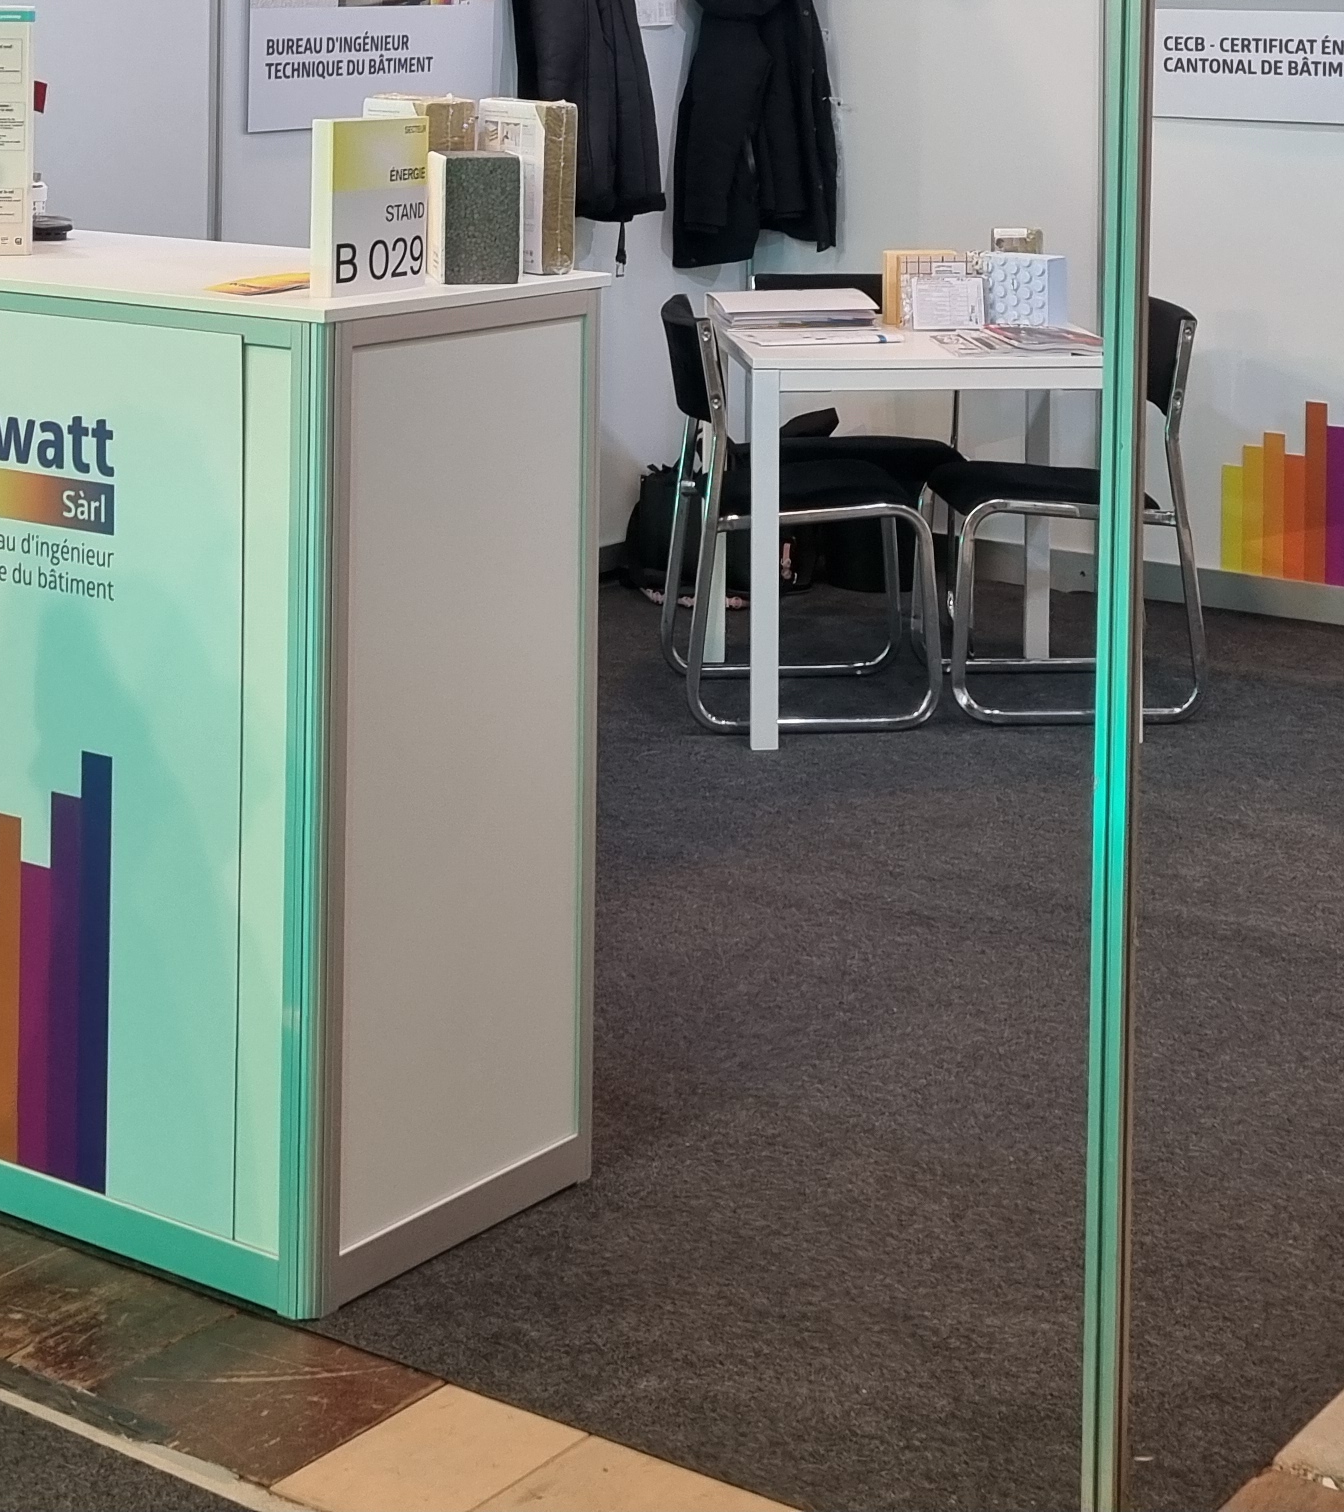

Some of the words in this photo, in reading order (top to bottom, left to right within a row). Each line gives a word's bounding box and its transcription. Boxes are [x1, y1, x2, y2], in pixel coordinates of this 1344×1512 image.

[265, 35, 322, 57] BUREAU
[325, 30, 410, 55] D'INGÉNIEUR
[1162, 35, 1206, 53] CECB
[1219, 37, 1317, 56] CERTIFICAT
[265, 58, 343, 80] TECHNIQUE
[346, 57, 365, 77] DU
[368, 51, 433, 76] BÂTIMENT
[1162, 56, 1257, 76] CANTONAL
[1260, 58, 1284, 77] DE
[389, 166, 426, 182] ÉNERGIE
[385, 201, 425, 223] STAND
[335, 242, 357, 284] B
[368, 235, 424, 281] 029
[62, 490, 106, 523] Sàrl
[20, 533, 115, 569] d'ingénieur
[12, 566, 32, 586] du
[37, 568, 115, 602] bâtiment
